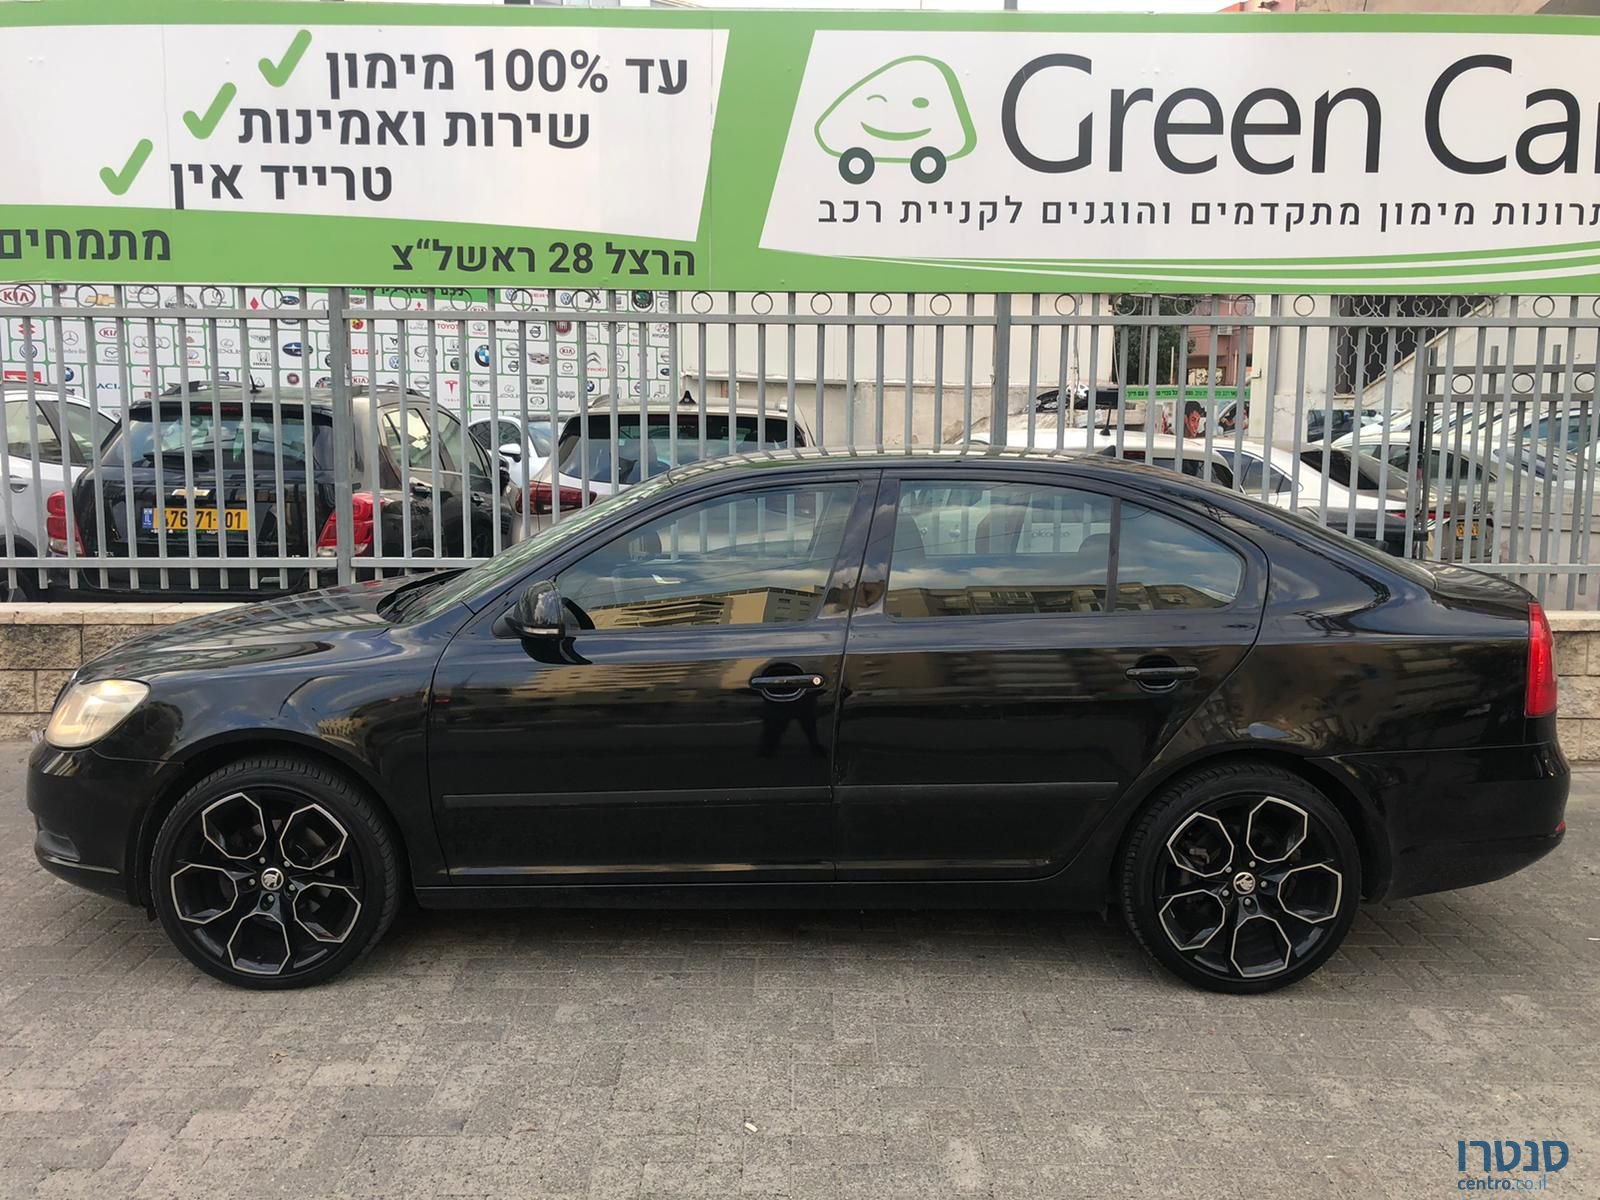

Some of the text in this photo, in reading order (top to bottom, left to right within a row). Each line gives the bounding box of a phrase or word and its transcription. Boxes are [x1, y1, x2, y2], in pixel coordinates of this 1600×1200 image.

[326, 48, 688, 100] עד 100% מימון
[238, 108, 589, 149] שירות ואמינות
[1001, 53, 1600, 175] Green Ca
[170, 163, 392, 210] טרייד אין
[818, 199, 882, 223] רכב
[900, 195, 1023, 230] לקניית
[1042, 200, 1171, 225] והוגנים
[1191, 201, 1359, 232] מתקדמים
[1380, 202, 1475, 232] מימון
[0, 229, 171, 260] מתמחים
[548, 242, 593, 274] 28
[605, 242, 695, 276] הרצל
[3, 291, 29, 302] KIA
[557, 390, 576, 401] eep
